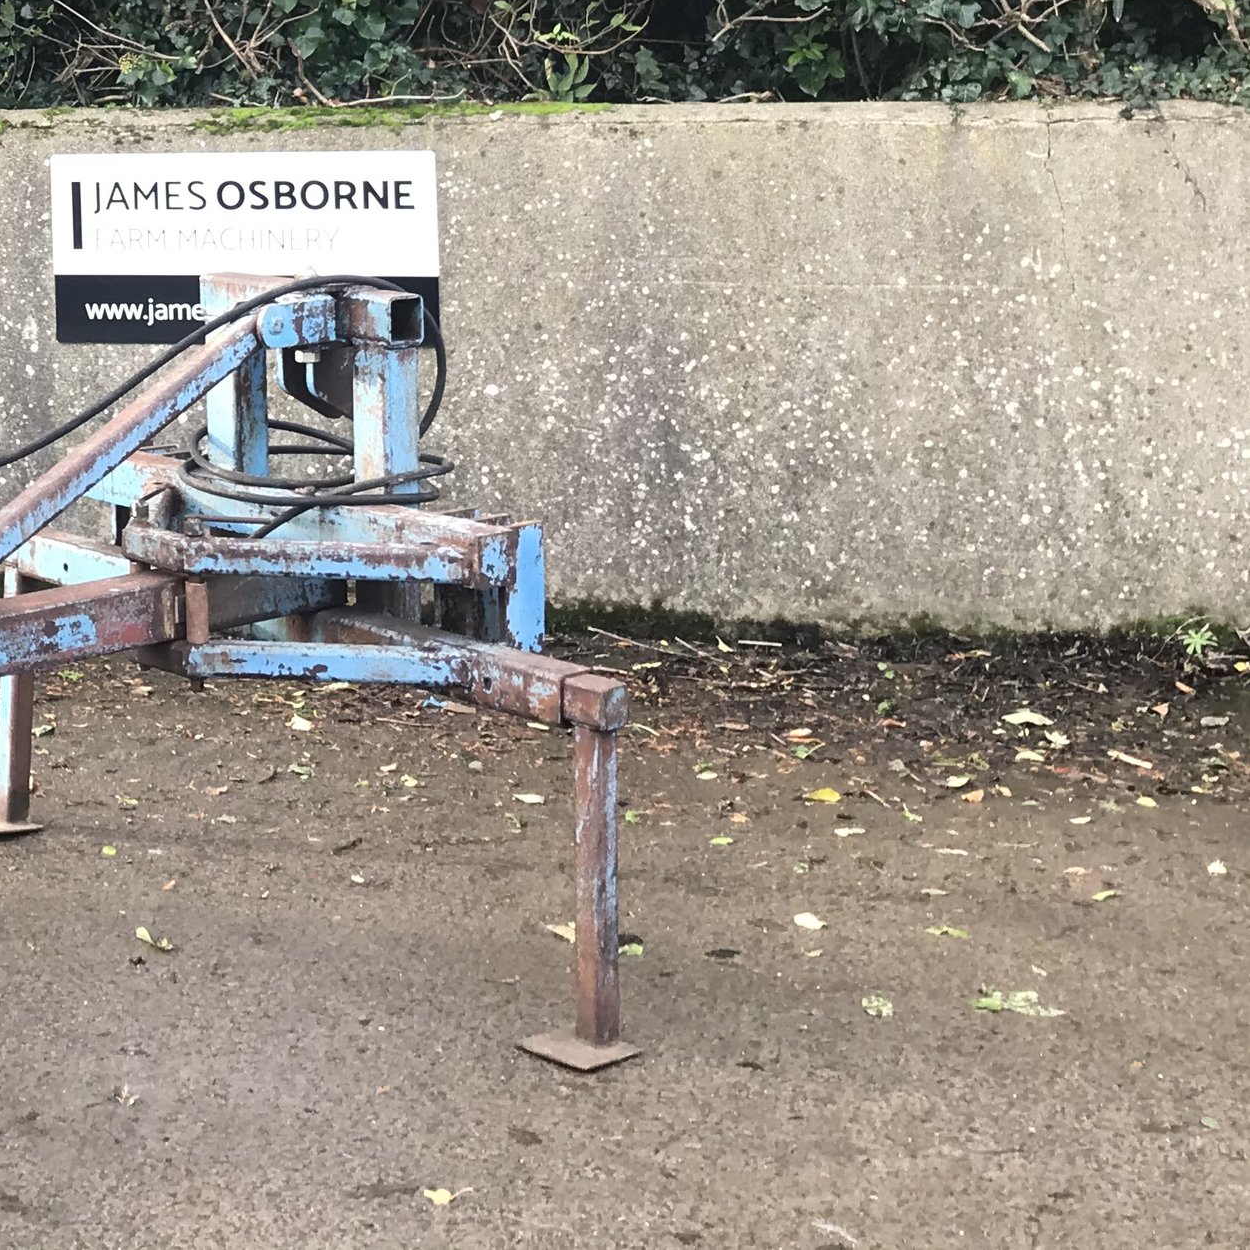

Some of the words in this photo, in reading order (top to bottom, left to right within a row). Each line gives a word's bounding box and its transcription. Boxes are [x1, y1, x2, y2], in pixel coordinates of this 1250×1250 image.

[94, 181, 207, 214] JAMES
[216, 180, 415, 210] OSBORNE
[95, 228, 167, 250] FARM
[178, 227, 339, 250] MACHINERY
